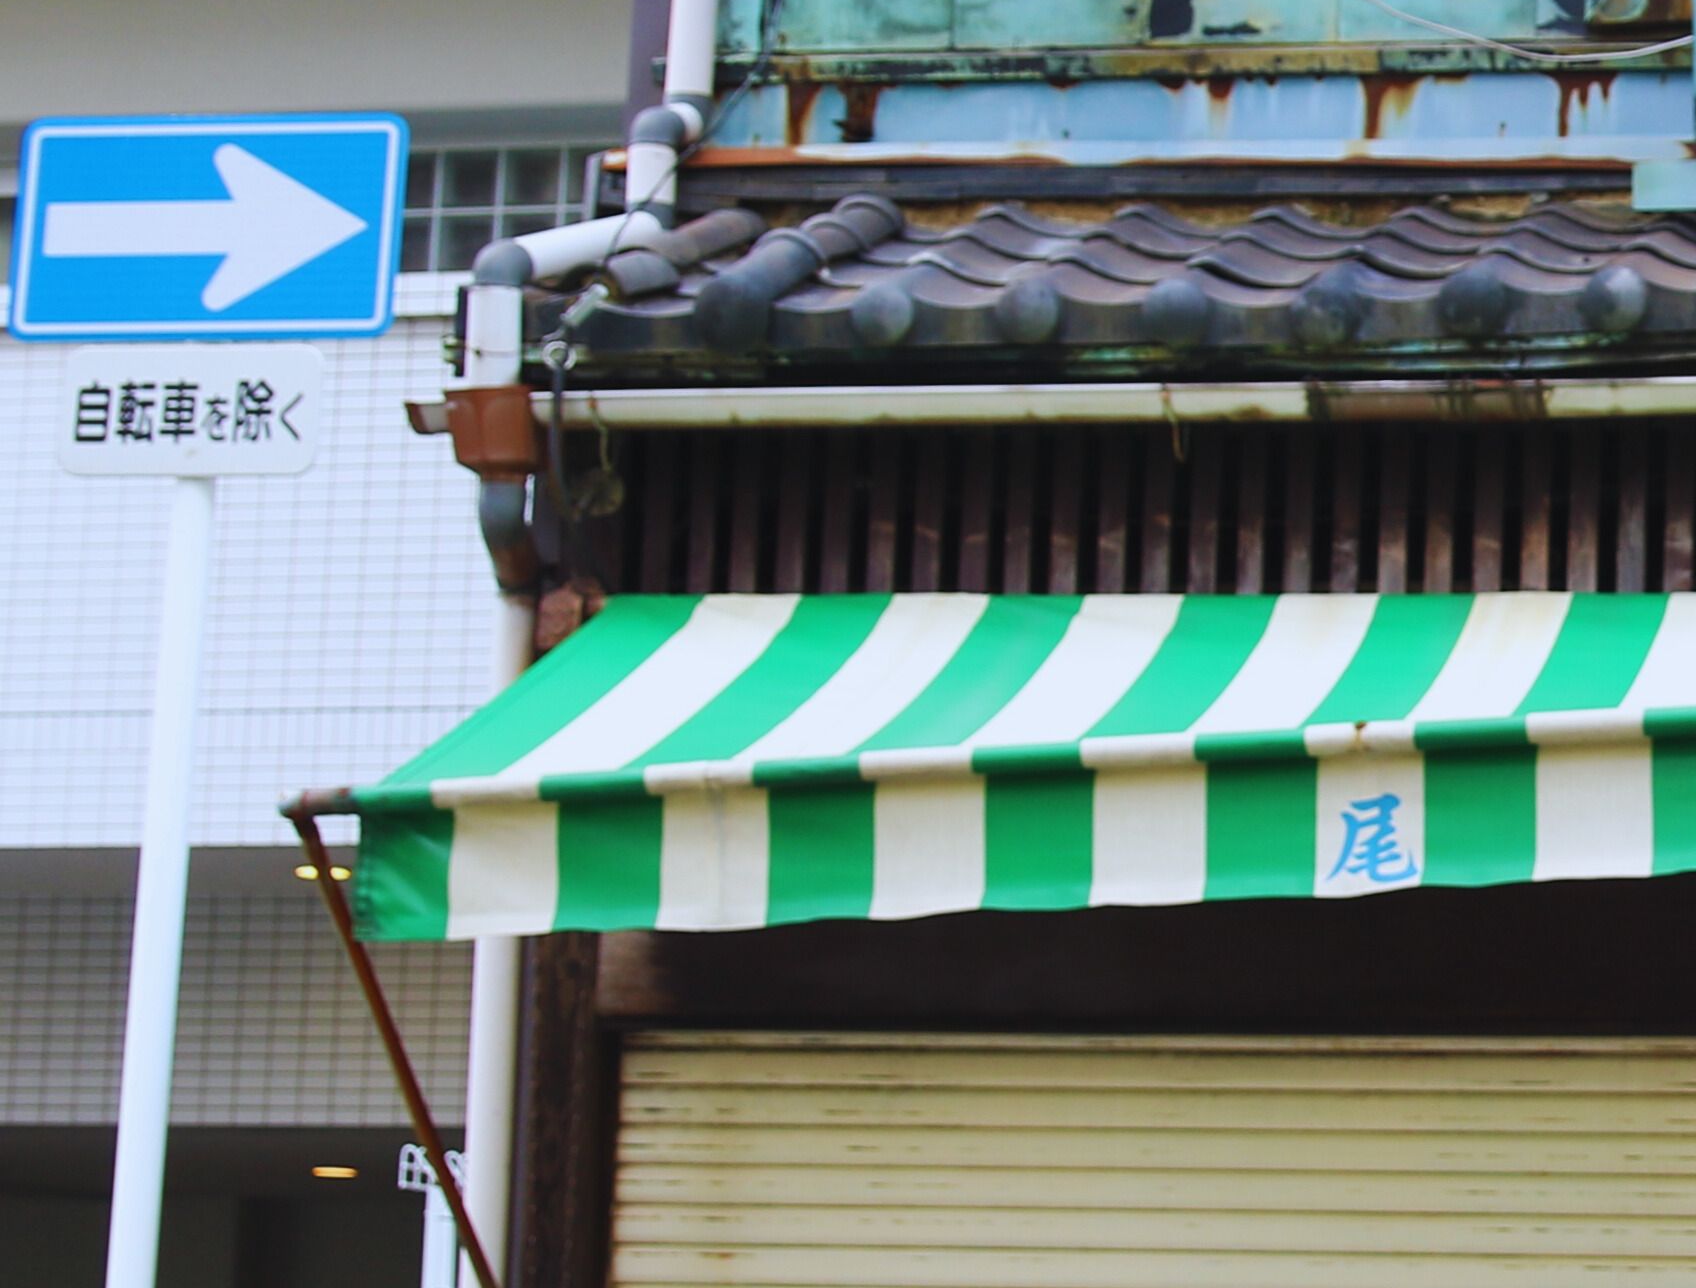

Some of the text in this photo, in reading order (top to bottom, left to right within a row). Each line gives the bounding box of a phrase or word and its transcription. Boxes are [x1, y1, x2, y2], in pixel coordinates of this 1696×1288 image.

[73, 380, 304, 443] 自転車を除く
